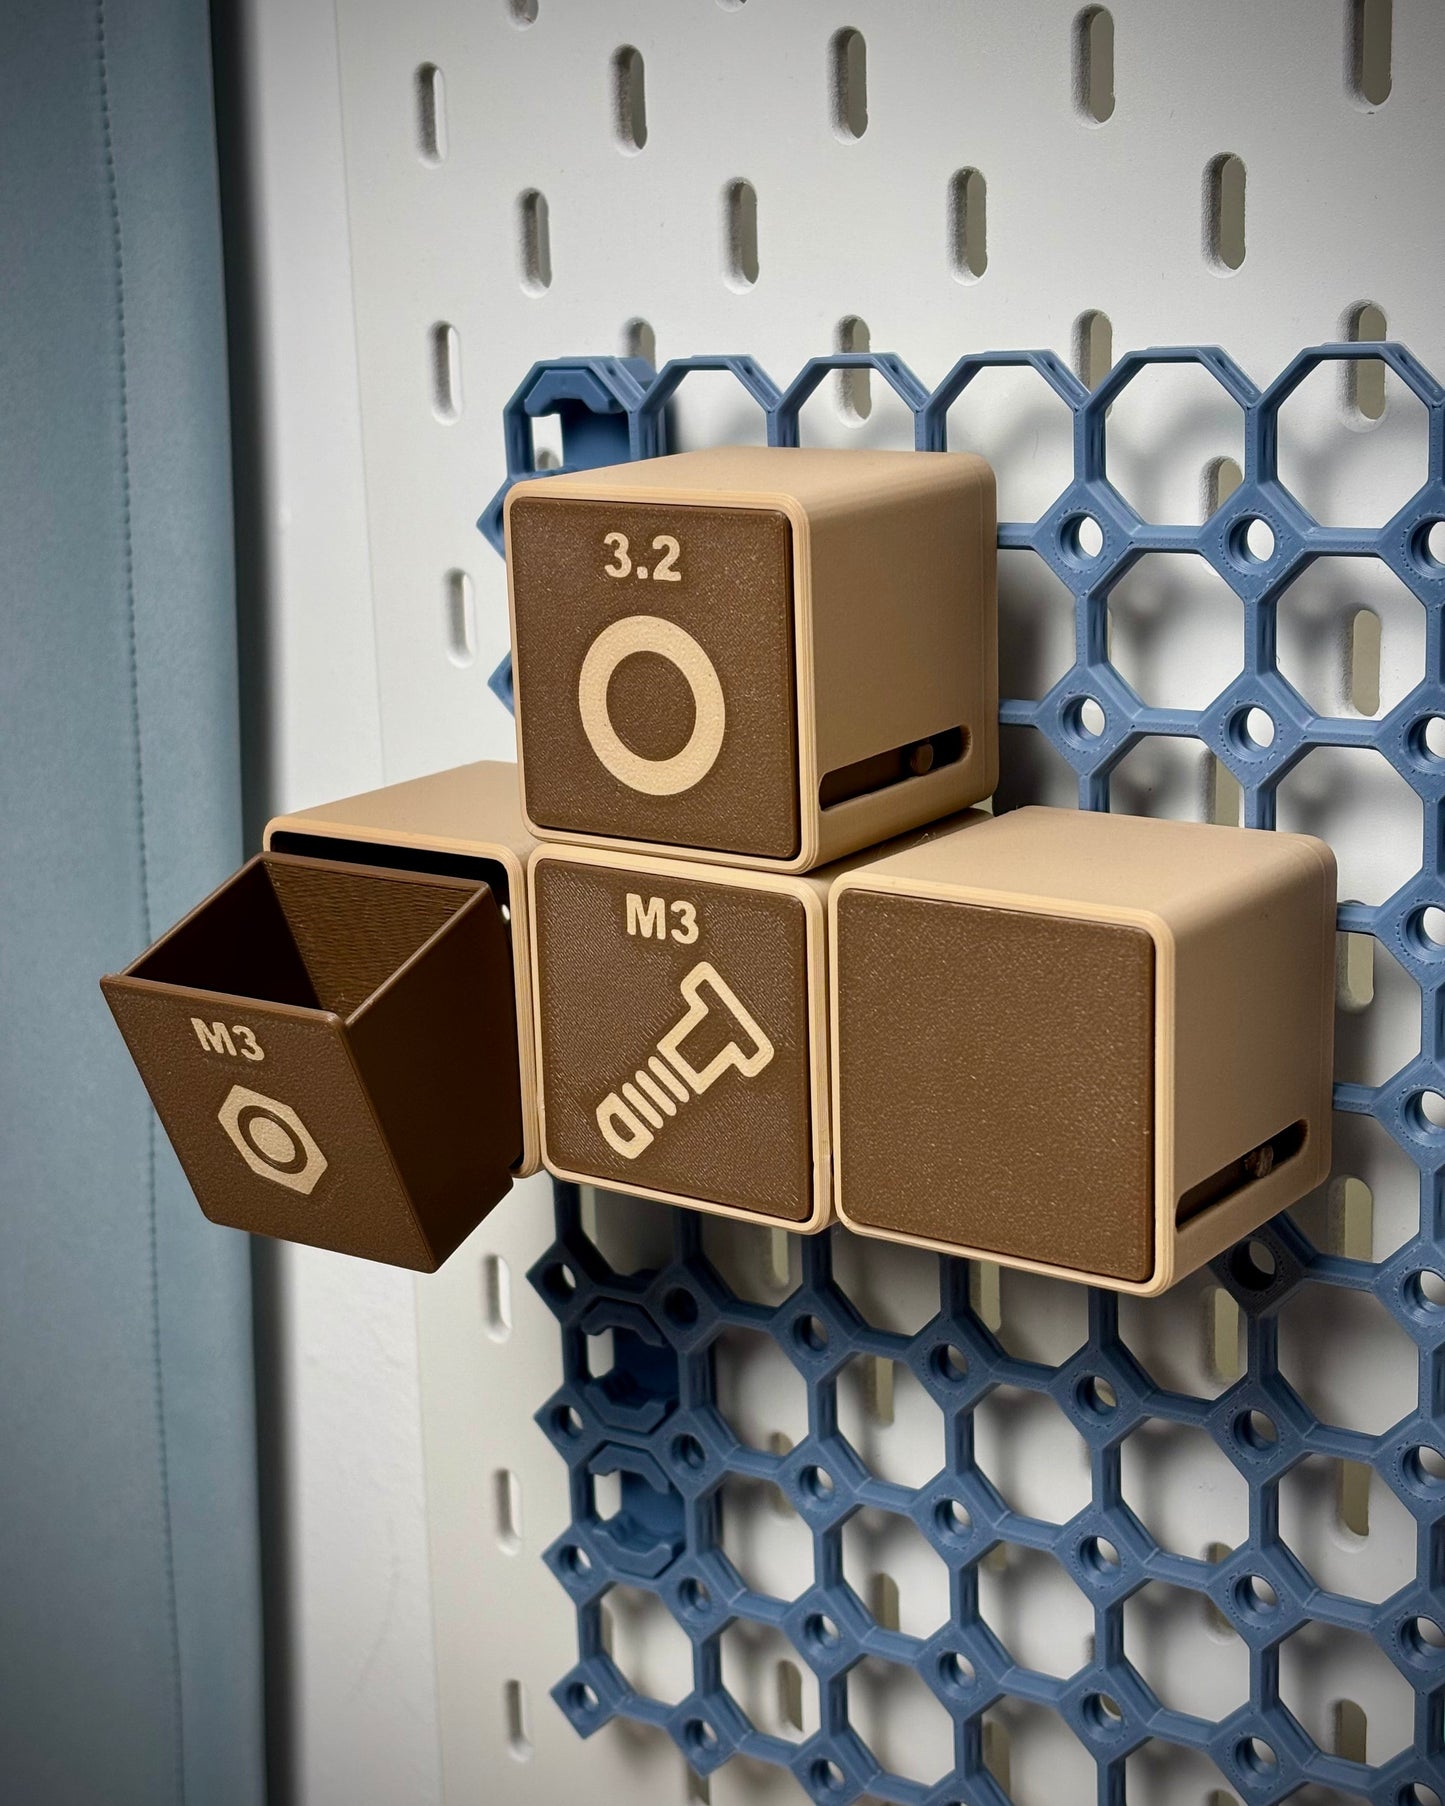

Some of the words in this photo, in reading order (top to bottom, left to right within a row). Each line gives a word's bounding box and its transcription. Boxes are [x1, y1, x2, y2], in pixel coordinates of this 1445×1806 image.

[603, 531, 682, 582] 3.2
[625, 892, 699, 945] M3
[190, 1017, 265, 1062] M3
